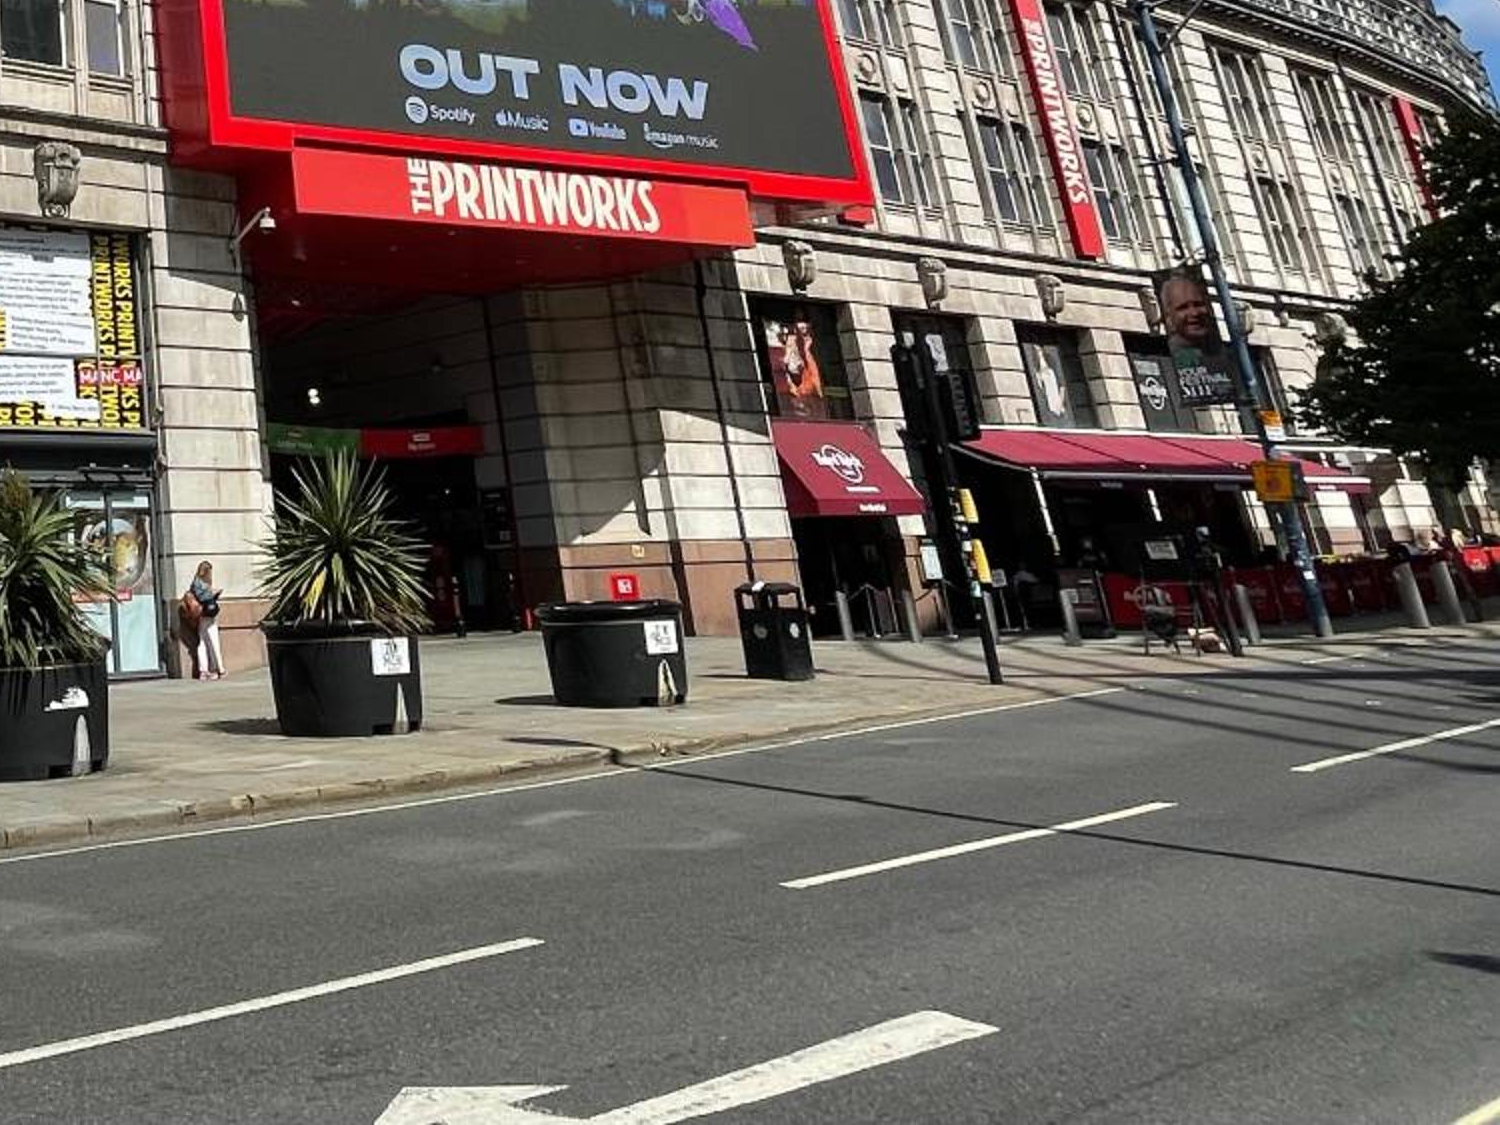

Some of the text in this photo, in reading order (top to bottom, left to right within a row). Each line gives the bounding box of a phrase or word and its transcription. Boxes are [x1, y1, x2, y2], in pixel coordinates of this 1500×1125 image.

[399, 43, 709, 120] OUT NOW
[1026, 27, 1090, 205] PRINTWORKS
[430, 105, 477, 126] Spotify
[507, 110, 549, 132] Music
[686, 133, 719, 149] music
[407, 158, 433, 214] THE
[429, 159, 661, 233] PRINTWORKS
